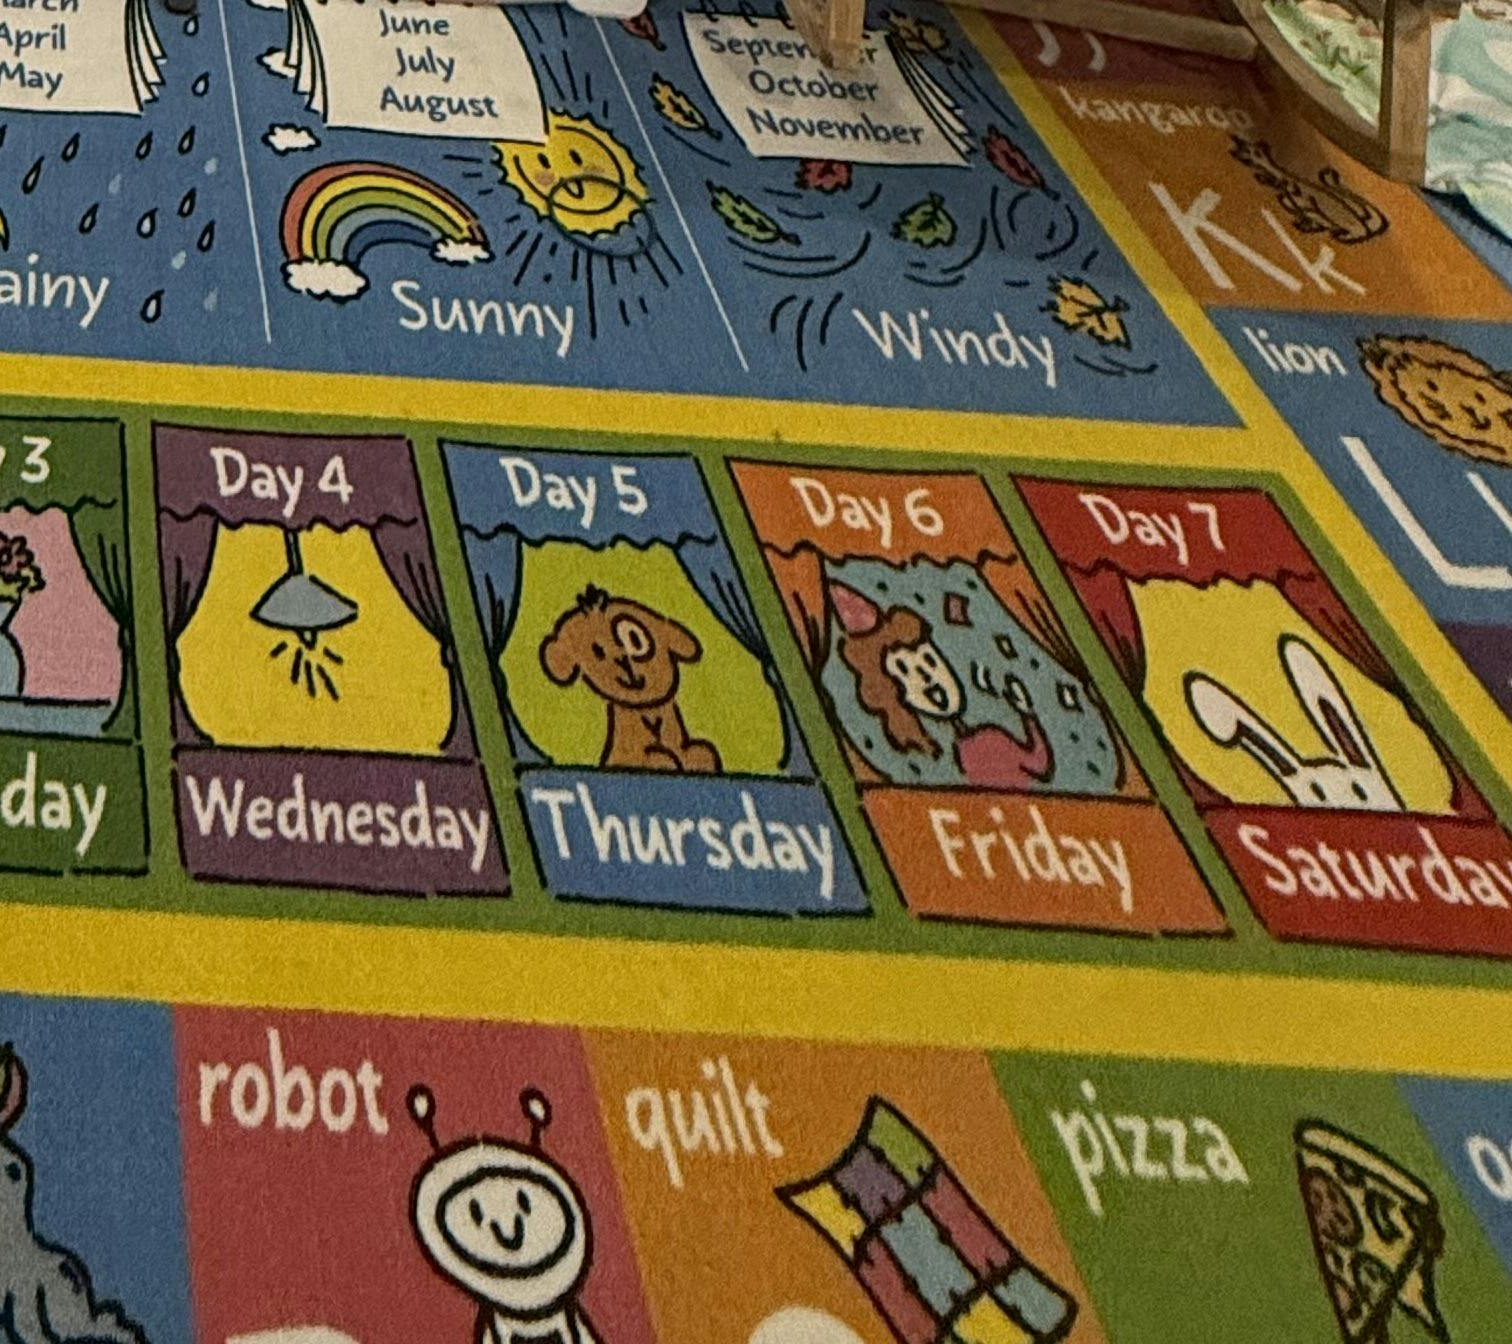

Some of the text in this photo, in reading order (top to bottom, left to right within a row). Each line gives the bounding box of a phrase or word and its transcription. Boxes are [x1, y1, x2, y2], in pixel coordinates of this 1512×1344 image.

[379, 8, 451, 39] June
[395, 46, 456, 83] July
[748, 69, 879, 102] October
[380, 87, 499, 124] August
[745, 107, 925, 145] November
[1149, 181, 1367, 296] Kk
[389, 281, 575, 358] Sunny
[852, 308, 1058, 387] Windy
[1242, 325, 1348, 378] lion
[20, 435, 51, 485] 3
[209, 447, 355, 516] Day 4
[499, 456, 648, 529] Day 5
[790, 477, 945, 548] Day 6
[1080, 493, 1225, 567] Day 7
[186, 773, 490, 874] Wednesday
[531, 783, 834, 900] Thursday
[929, 805, 1134, 914] Friday
[199, 1029, 390, 1136] robot
[624, 1056, 786, 1190] quilt
[1052, 1079, 1251, 1218] pizza
